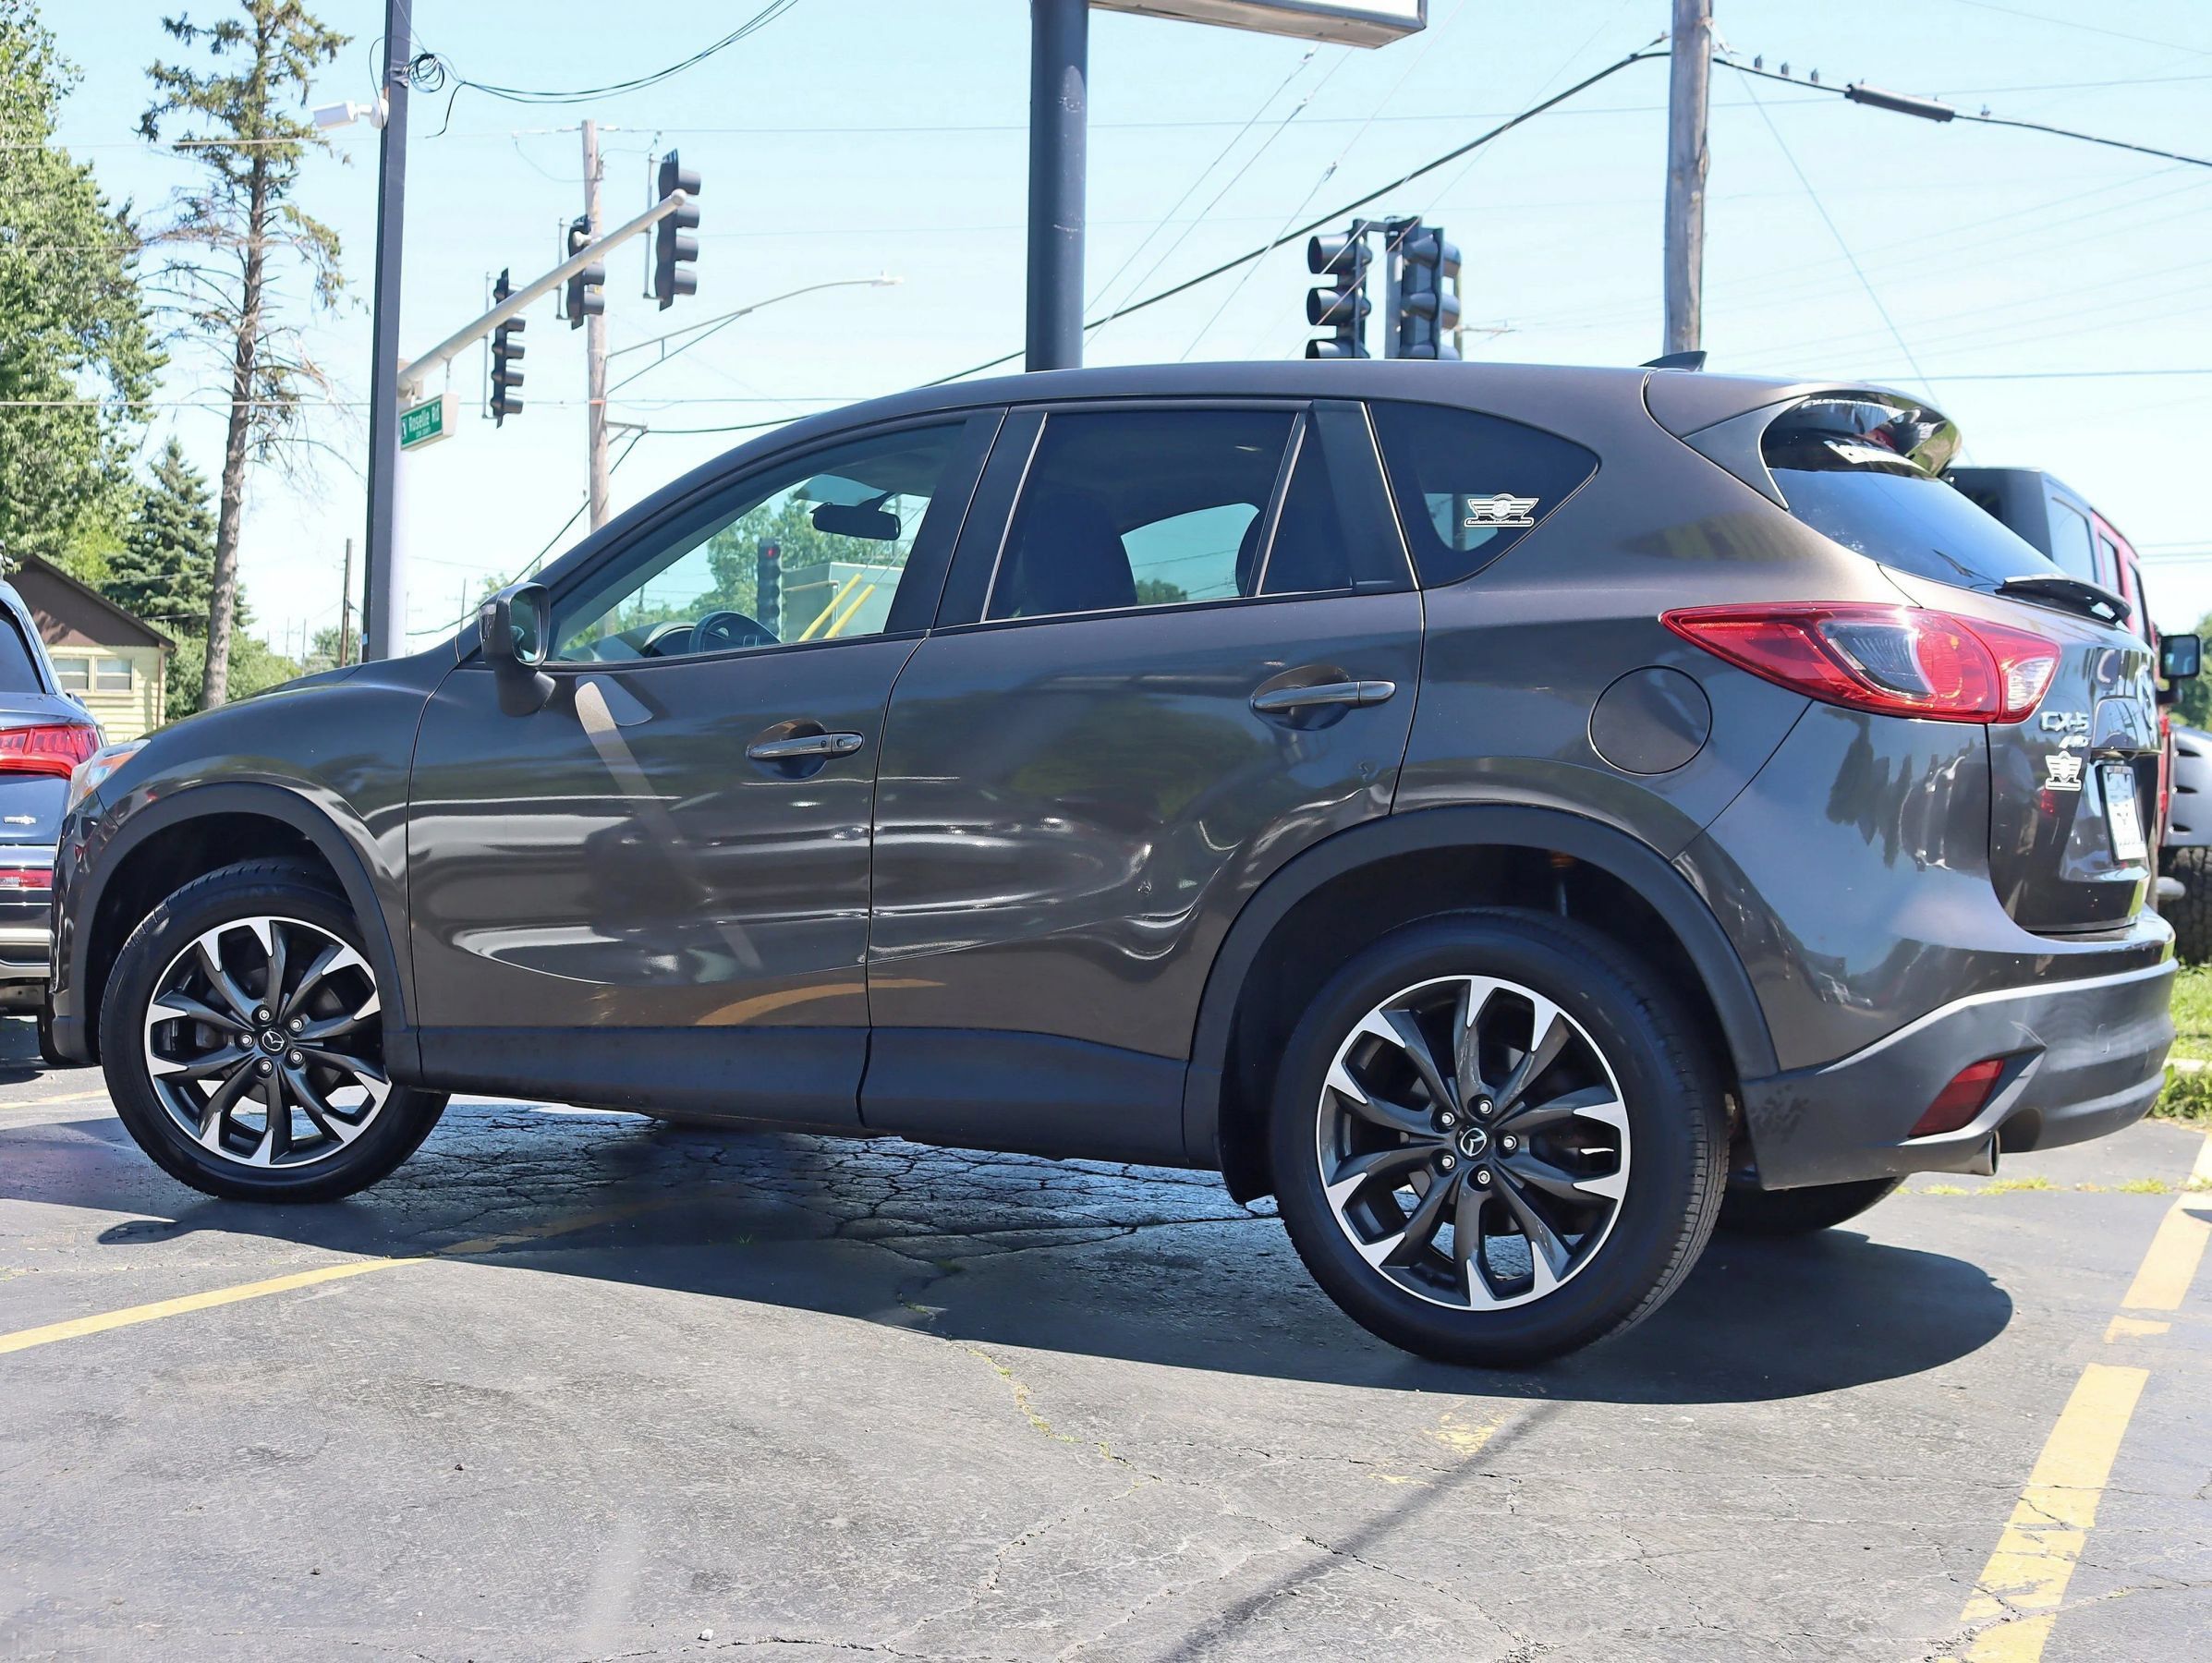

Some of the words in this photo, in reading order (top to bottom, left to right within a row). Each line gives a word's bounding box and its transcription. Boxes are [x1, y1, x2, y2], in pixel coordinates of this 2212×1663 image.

[408, 408, 431, 432] Roselle
[431, 403, 440, 423] Rd
[2040, 711, 2089, 732] CX-5
